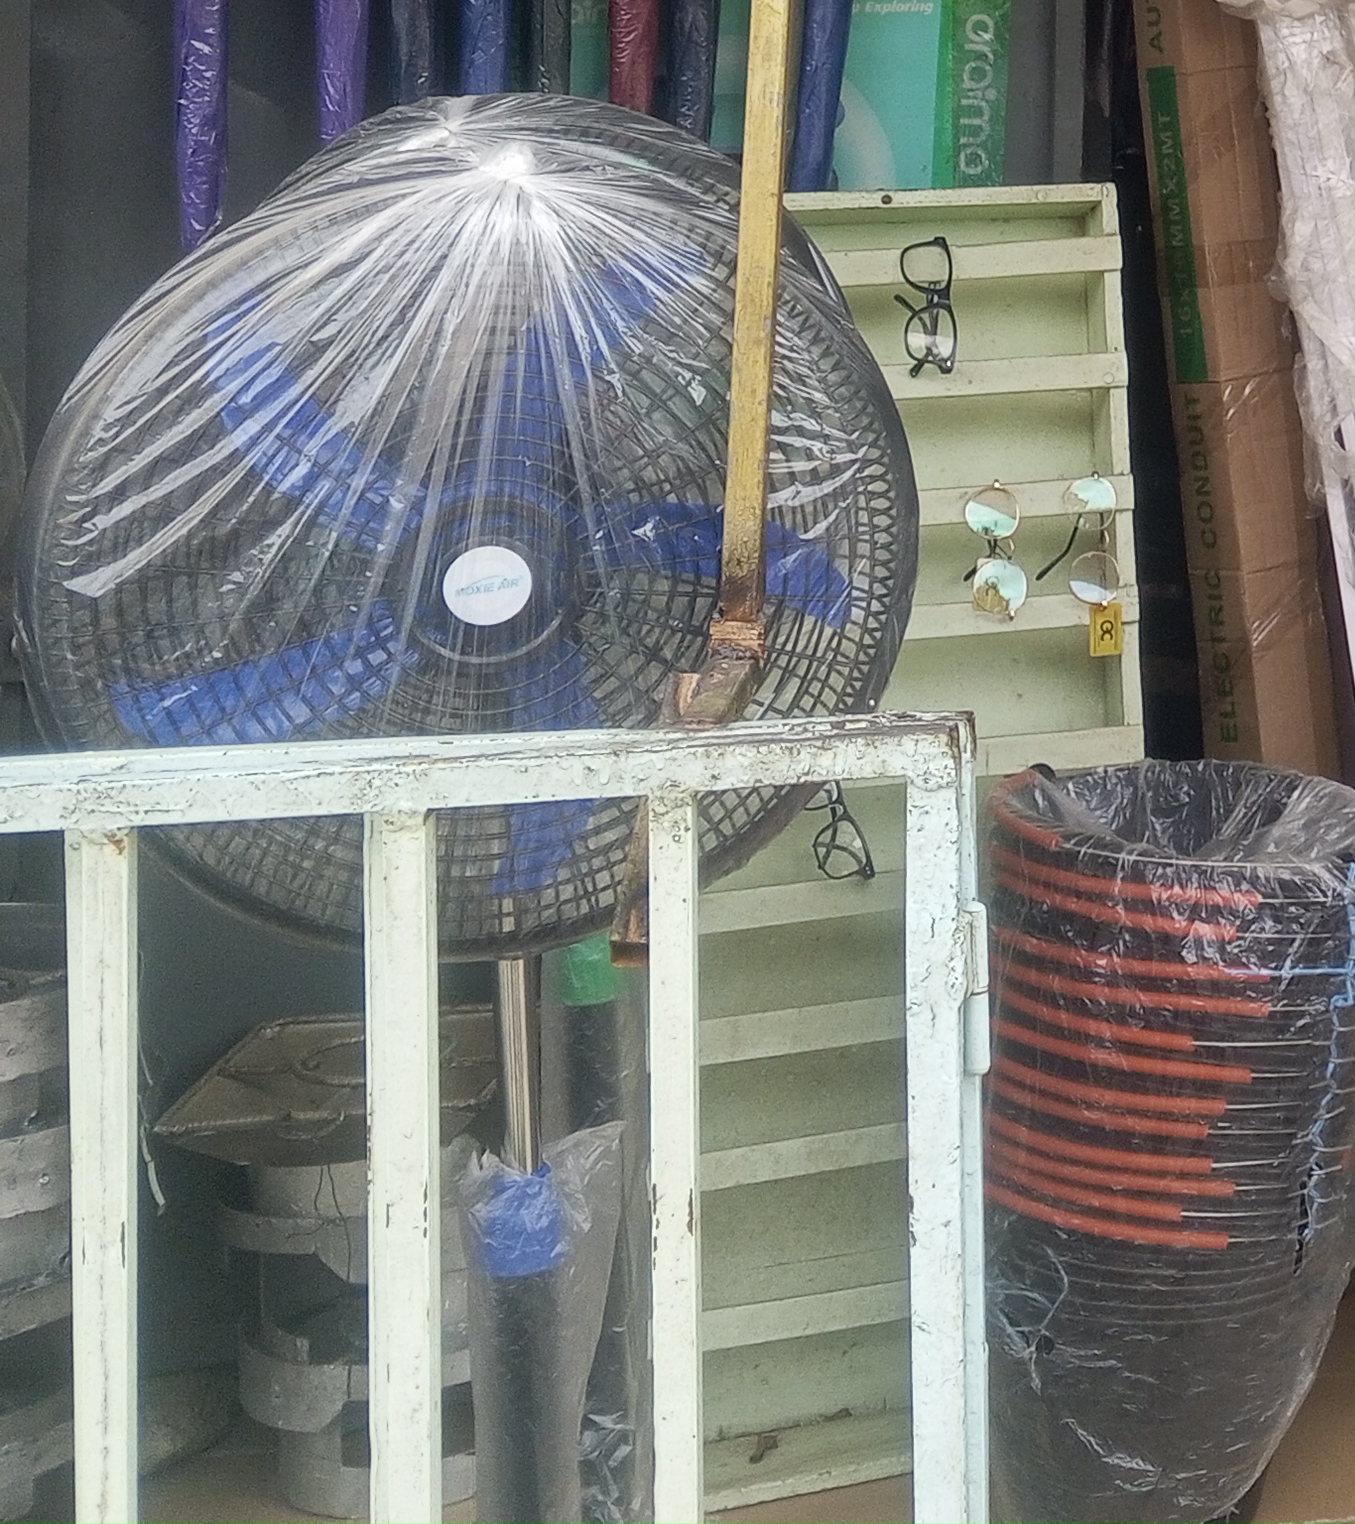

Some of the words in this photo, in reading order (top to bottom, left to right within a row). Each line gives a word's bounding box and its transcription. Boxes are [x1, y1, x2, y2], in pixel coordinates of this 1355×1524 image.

[865, 0, 933, 14] Exploring
[958, 13, 995, 176] oraimo
[1184, 395, 1217, 549] CONDUIT
[1205, 570, 1239, 745] ELECTRIC
